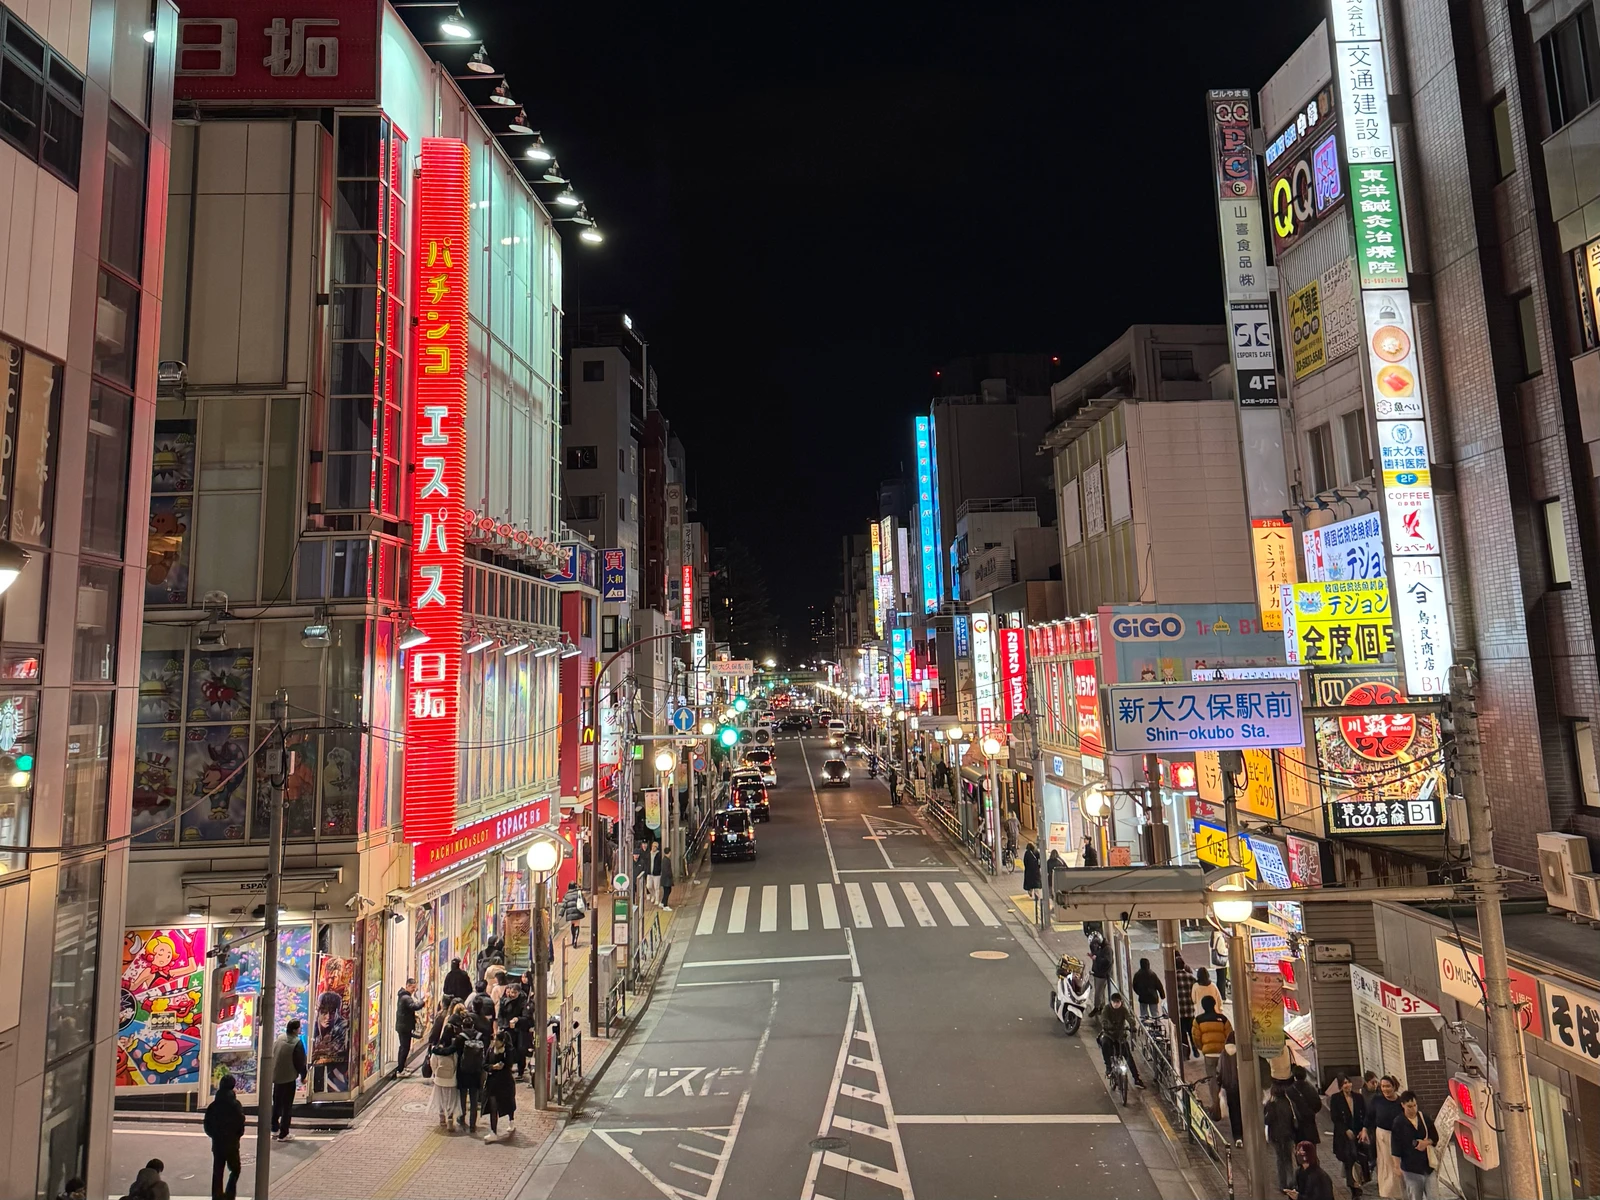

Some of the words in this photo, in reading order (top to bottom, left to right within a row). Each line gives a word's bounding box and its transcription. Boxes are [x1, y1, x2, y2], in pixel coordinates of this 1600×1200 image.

[1347, 44, 1380, 141] 交通建設
[1215, 103, 1249, 122] QQ
[1222, 128, 1249, 178] PC
[1351, 148, 1366, 159] 5F
[1373, 147, 1388, 158] 6F
[1233, 183, 1246, 193] 6F
[425, 236, 453, 374] パチンコ
[1249, 375, 1276, 390] 4F
[1382, 445, 1425, 457] 新大久保
[1384, 458, 1427, 469] 歯科医院
[1400, 474, 1414, 483] 2F
[1388, 491, 1430, 500] COFFEE
[417, 406, 448, 610] エスパス
[1395, 543, 1434, 552] シュベール
[604, 550, 624, 571] 質
[606, 574, 623, 584] 大和
[1265, 544, 1280, 609] ミライザカ
[1113, 617, 1182, 637] GiGO
[1196, 620, 1211, 635] 1F
[1282, 587, 1297, 662] エレベーター有
[1007, 631, 1020, 674] カラオケ
[1075, 674, 1096, 697] カラオケ
[1421, 677, 1441, 692] B1
[1118, 690, 1292, 724] 新大久保駅前
[1146, 725, 1235, 742] Shin-okubo
[1241, 723, 1270, 739] Sta.
[1341, 801, 1405, 816] 貸切最大
[1411, 804, 1434, 822] B1
[496, 811, 528, 840] ESPACE
[1341, 812, 1406, 826] 100名様
[1454, 965, 1478, 988] MUFG
[1386, 994, 1397, 1011] 入口
[1401, 997, 1421, 1013] 3F
